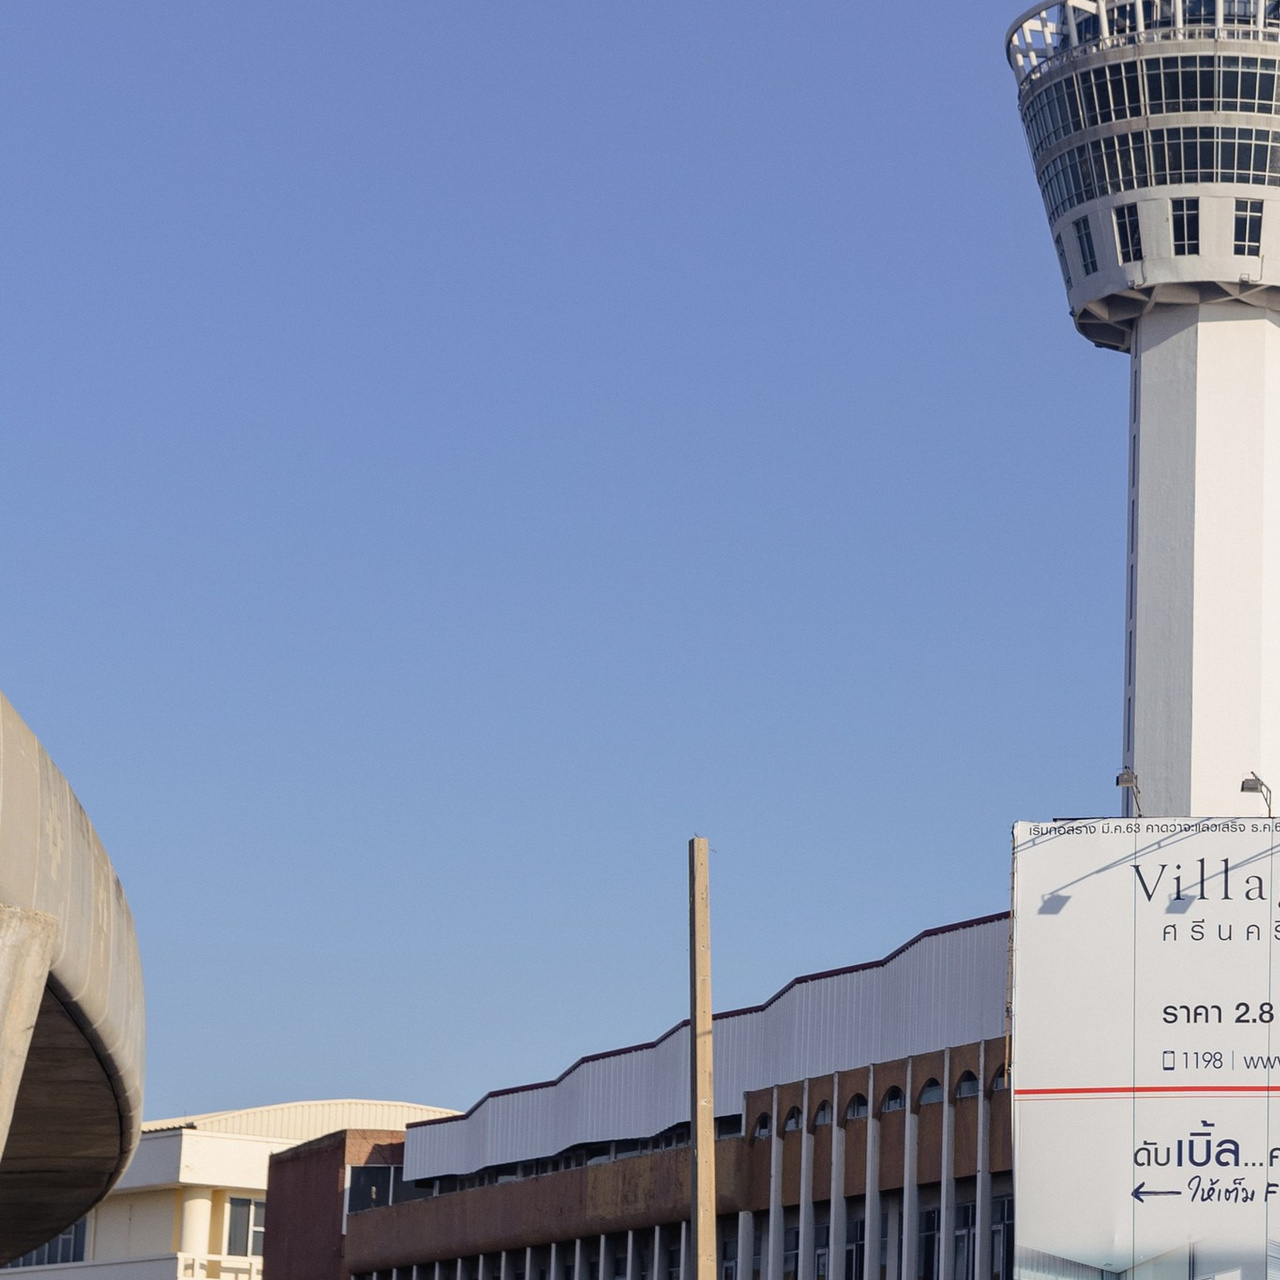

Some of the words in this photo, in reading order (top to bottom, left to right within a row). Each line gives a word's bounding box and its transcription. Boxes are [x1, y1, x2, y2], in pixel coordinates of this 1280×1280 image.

[1162, 1004, 1222, 1023] ราคา
[1182, 1052, 1223, 1070] 1198
[1188, 1176, 1255, 1203] ให้เต็ม
